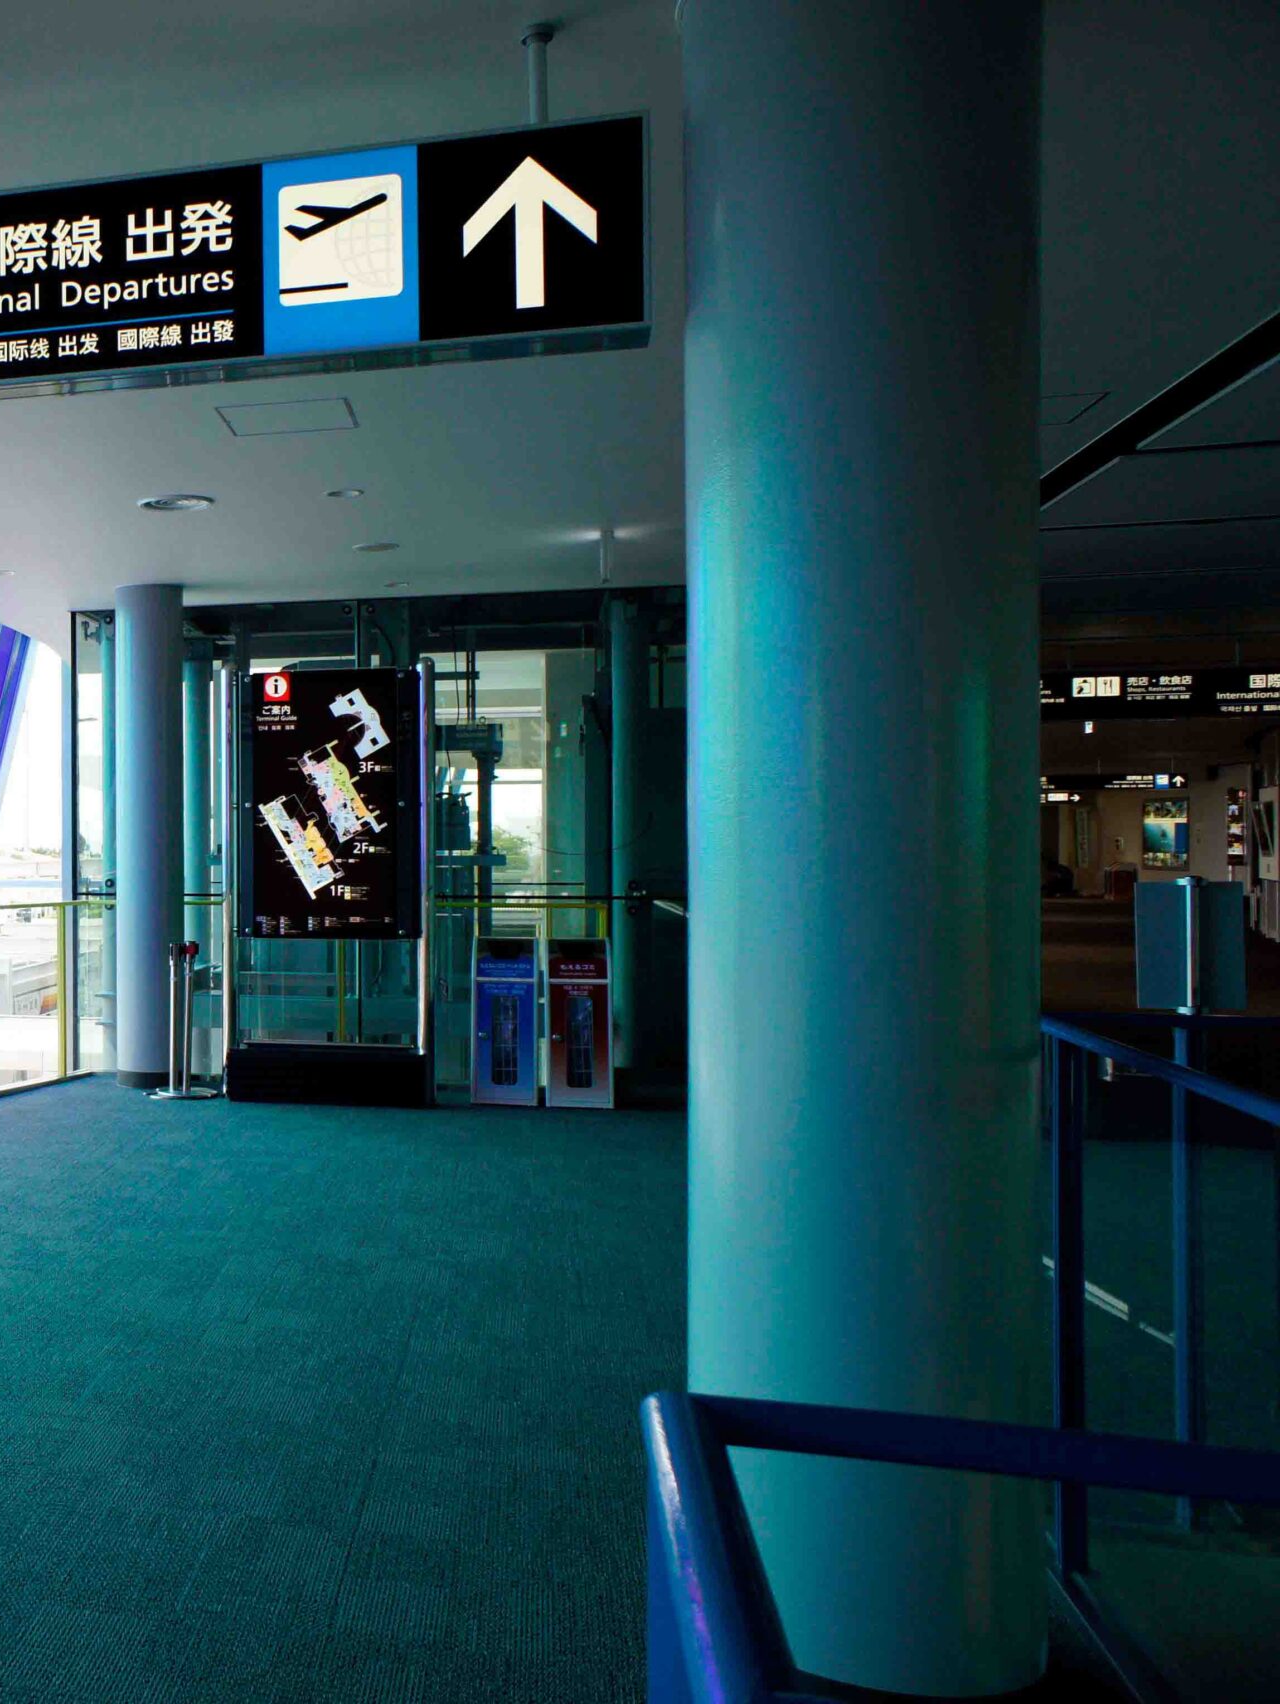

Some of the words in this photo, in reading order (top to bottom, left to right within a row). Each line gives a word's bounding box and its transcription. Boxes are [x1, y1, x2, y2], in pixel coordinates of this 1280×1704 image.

[126, 200, 234, 261] 出発
[62, 270, 234, 309] Departures
[58, 333, 99, 357] 出发
[117, 324, 182, 352] 國際線
[191, 320, 234, 344] 出發
[1216, 691, 1280, 700] Internationa
[262, 705, 291, 715] ご案内
[359, 761, 374, 773] 3F
[353, 842, 369, 854] 2F
[330, 885, 345, 897] 1F
